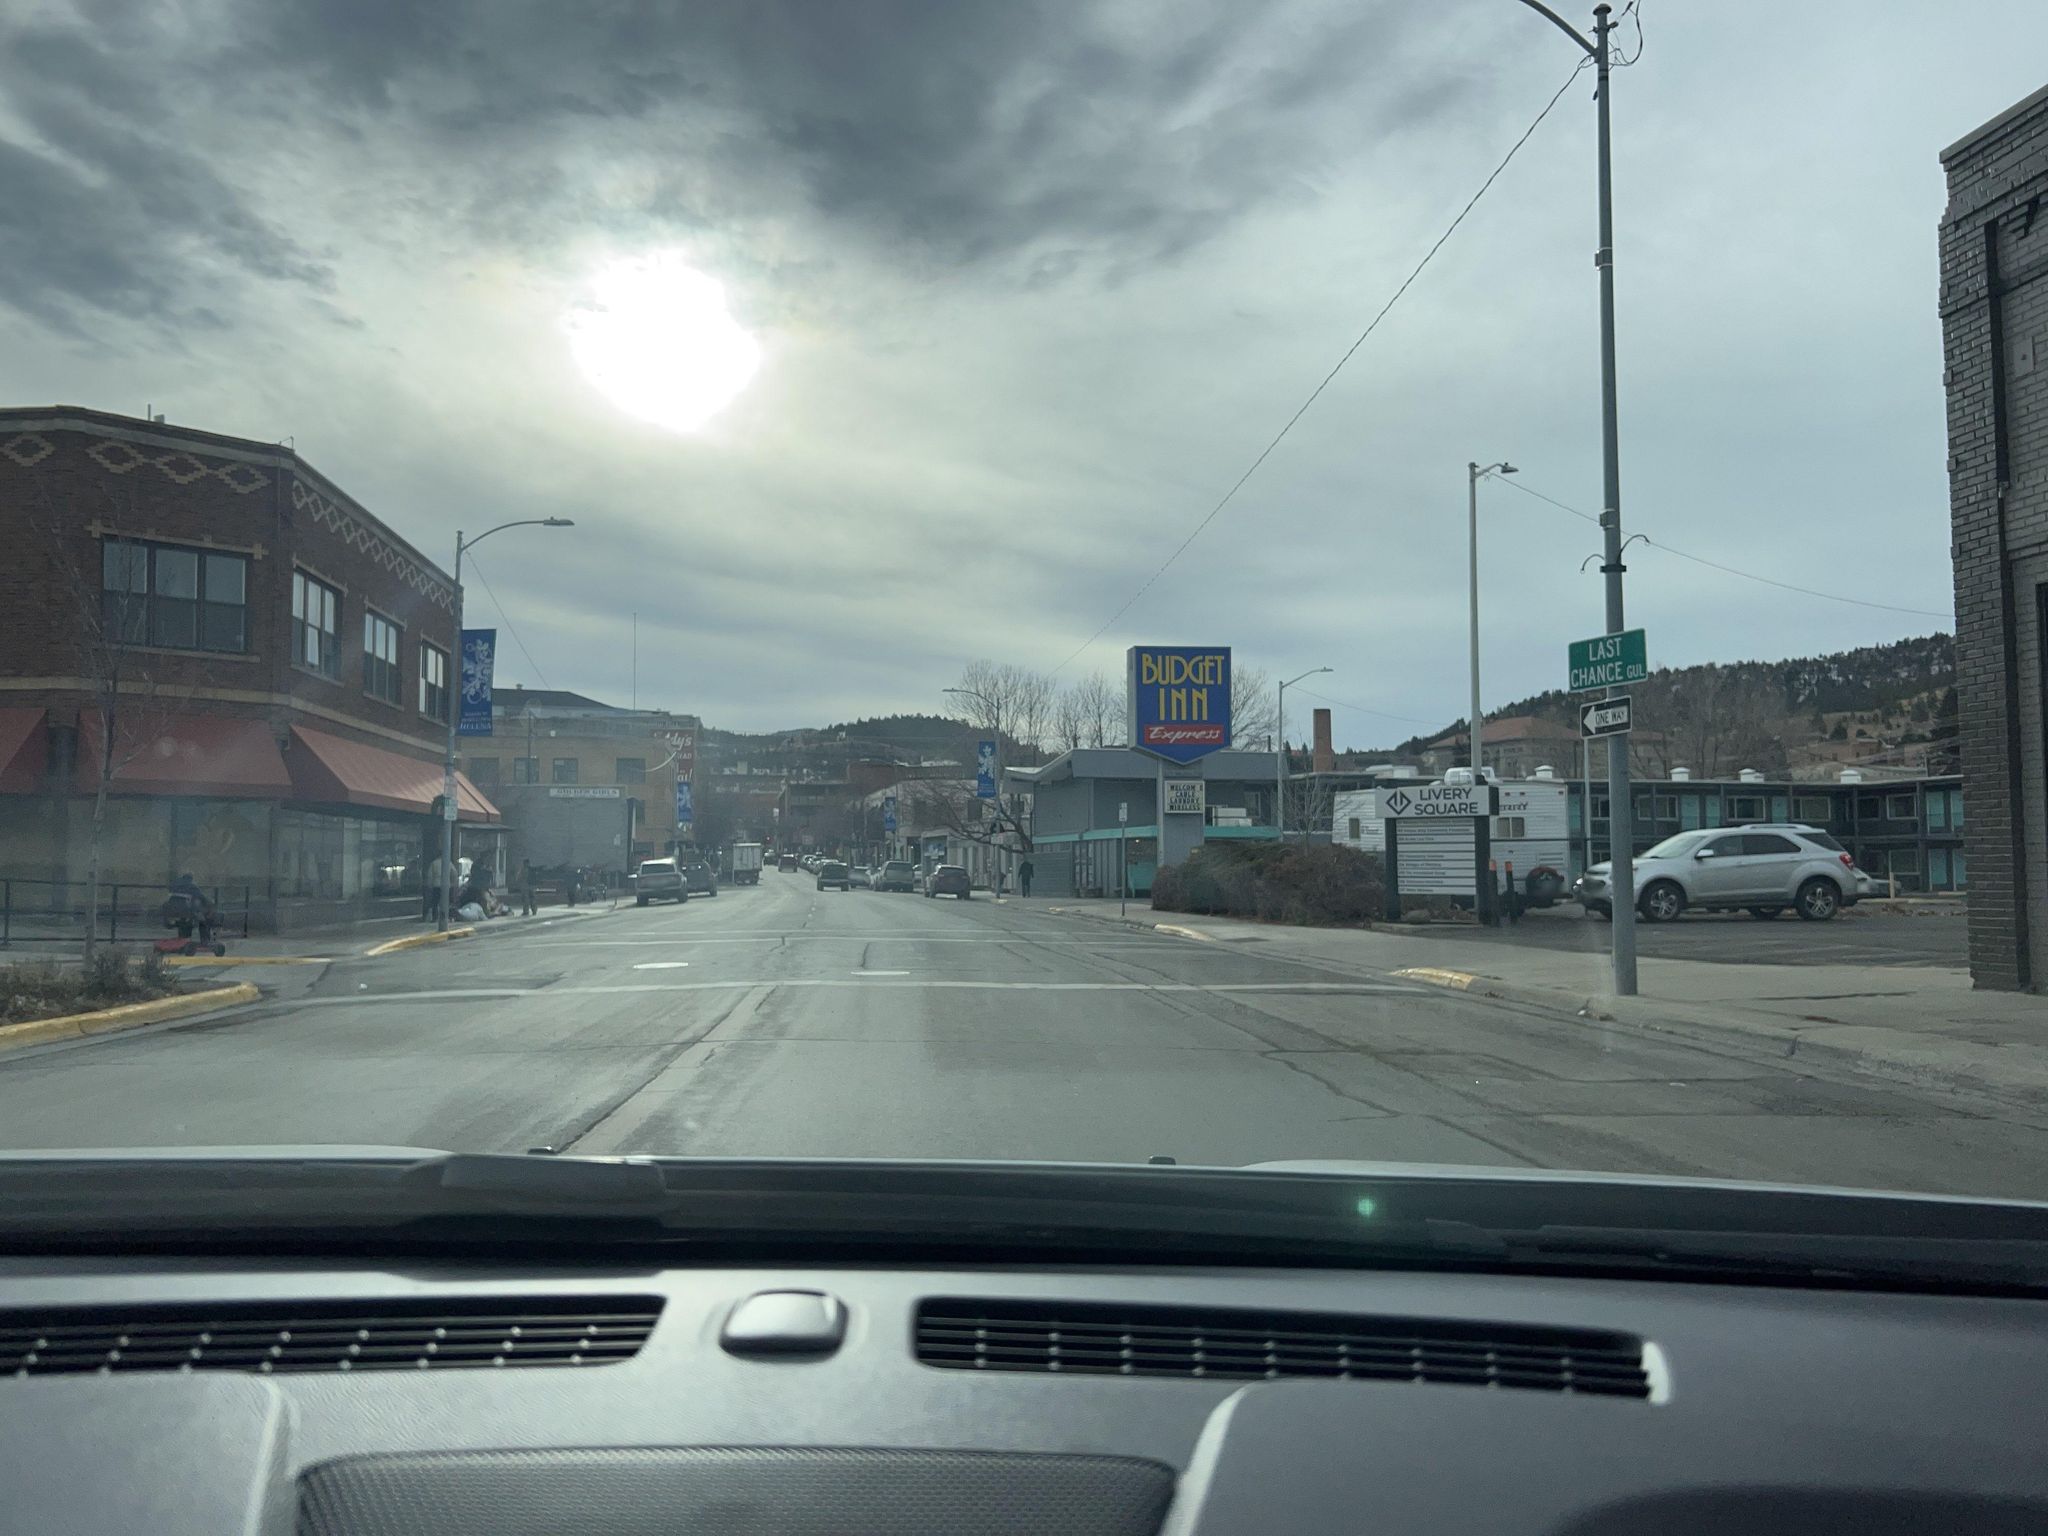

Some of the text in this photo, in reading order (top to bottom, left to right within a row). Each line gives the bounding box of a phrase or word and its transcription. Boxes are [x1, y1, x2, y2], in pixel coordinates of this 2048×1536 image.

[1588, 638, 1621, 661] LAST
[1142, 653, 1224, 685] BUDGET
[1571, 662, 1645, 688] CHANCE GUL
[1159, 688, 1208, 721] INN
[1595, 709, 1625, 726] ONE WAY
[1148, 727, 1220, 744] Express
[1419, 788, 1472, 801] LIVERY
[1414, 802, 1478, 815] SQUARE
